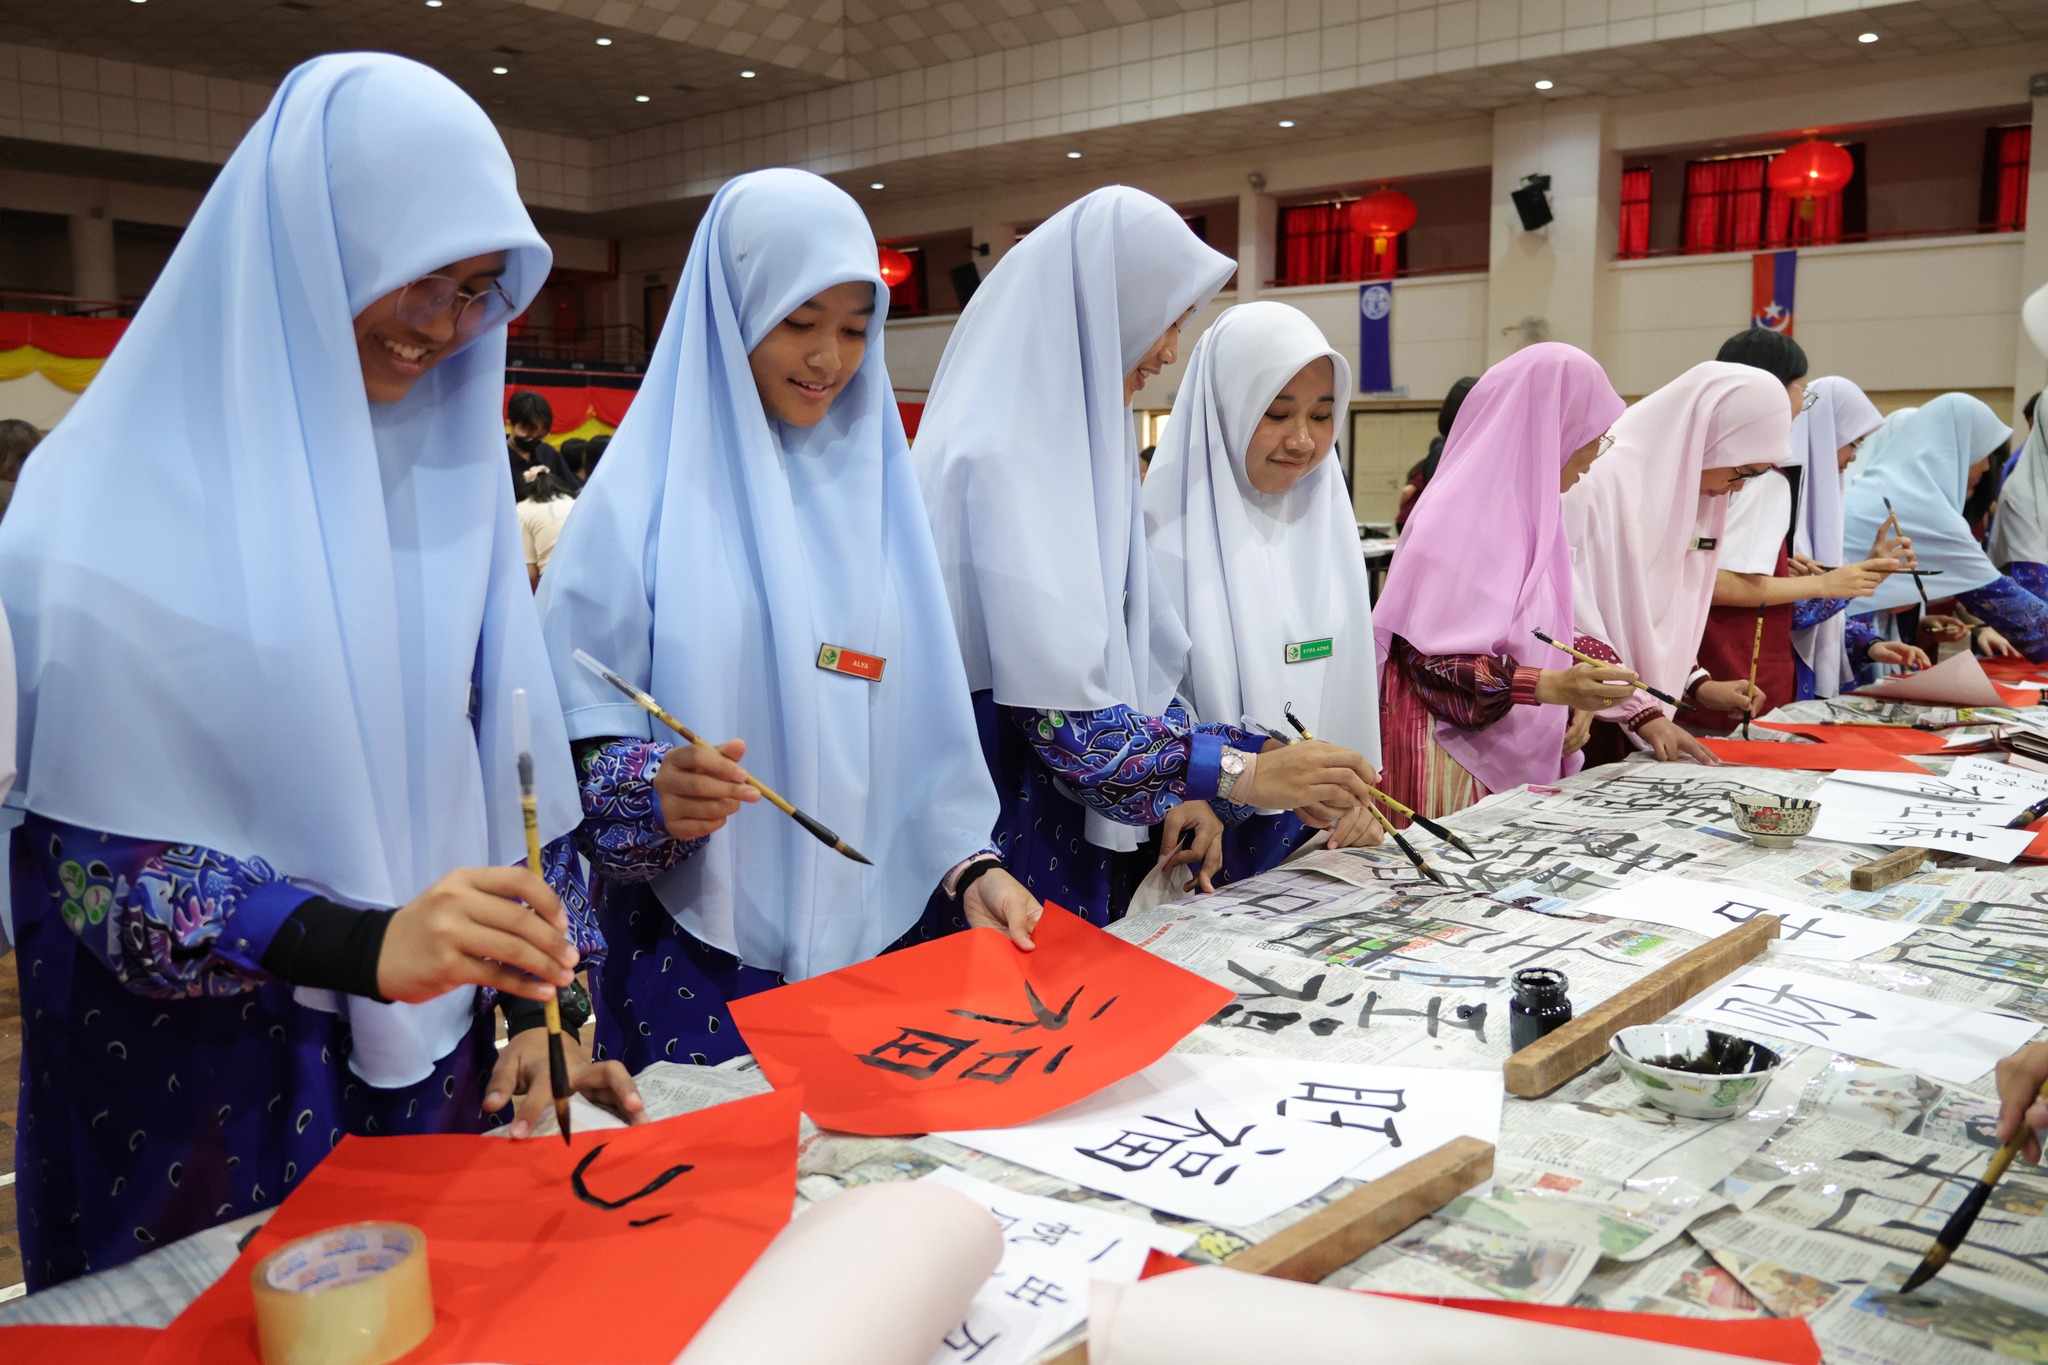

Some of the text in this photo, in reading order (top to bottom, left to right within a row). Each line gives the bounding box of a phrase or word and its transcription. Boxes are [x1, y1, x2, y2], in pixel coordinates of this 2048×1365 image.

[852, 660, 869, 670] ALYA
[1868, 825, 1989, 842] 春
[854, 978, 1119, 1085] 福
[1714, 983, 1879, 1042] 财
[1073, 1107, 1287, 1186] 福
[1003, 1274, 1069, 1308] 出
[942, 1321, 1002, 1364] 万
